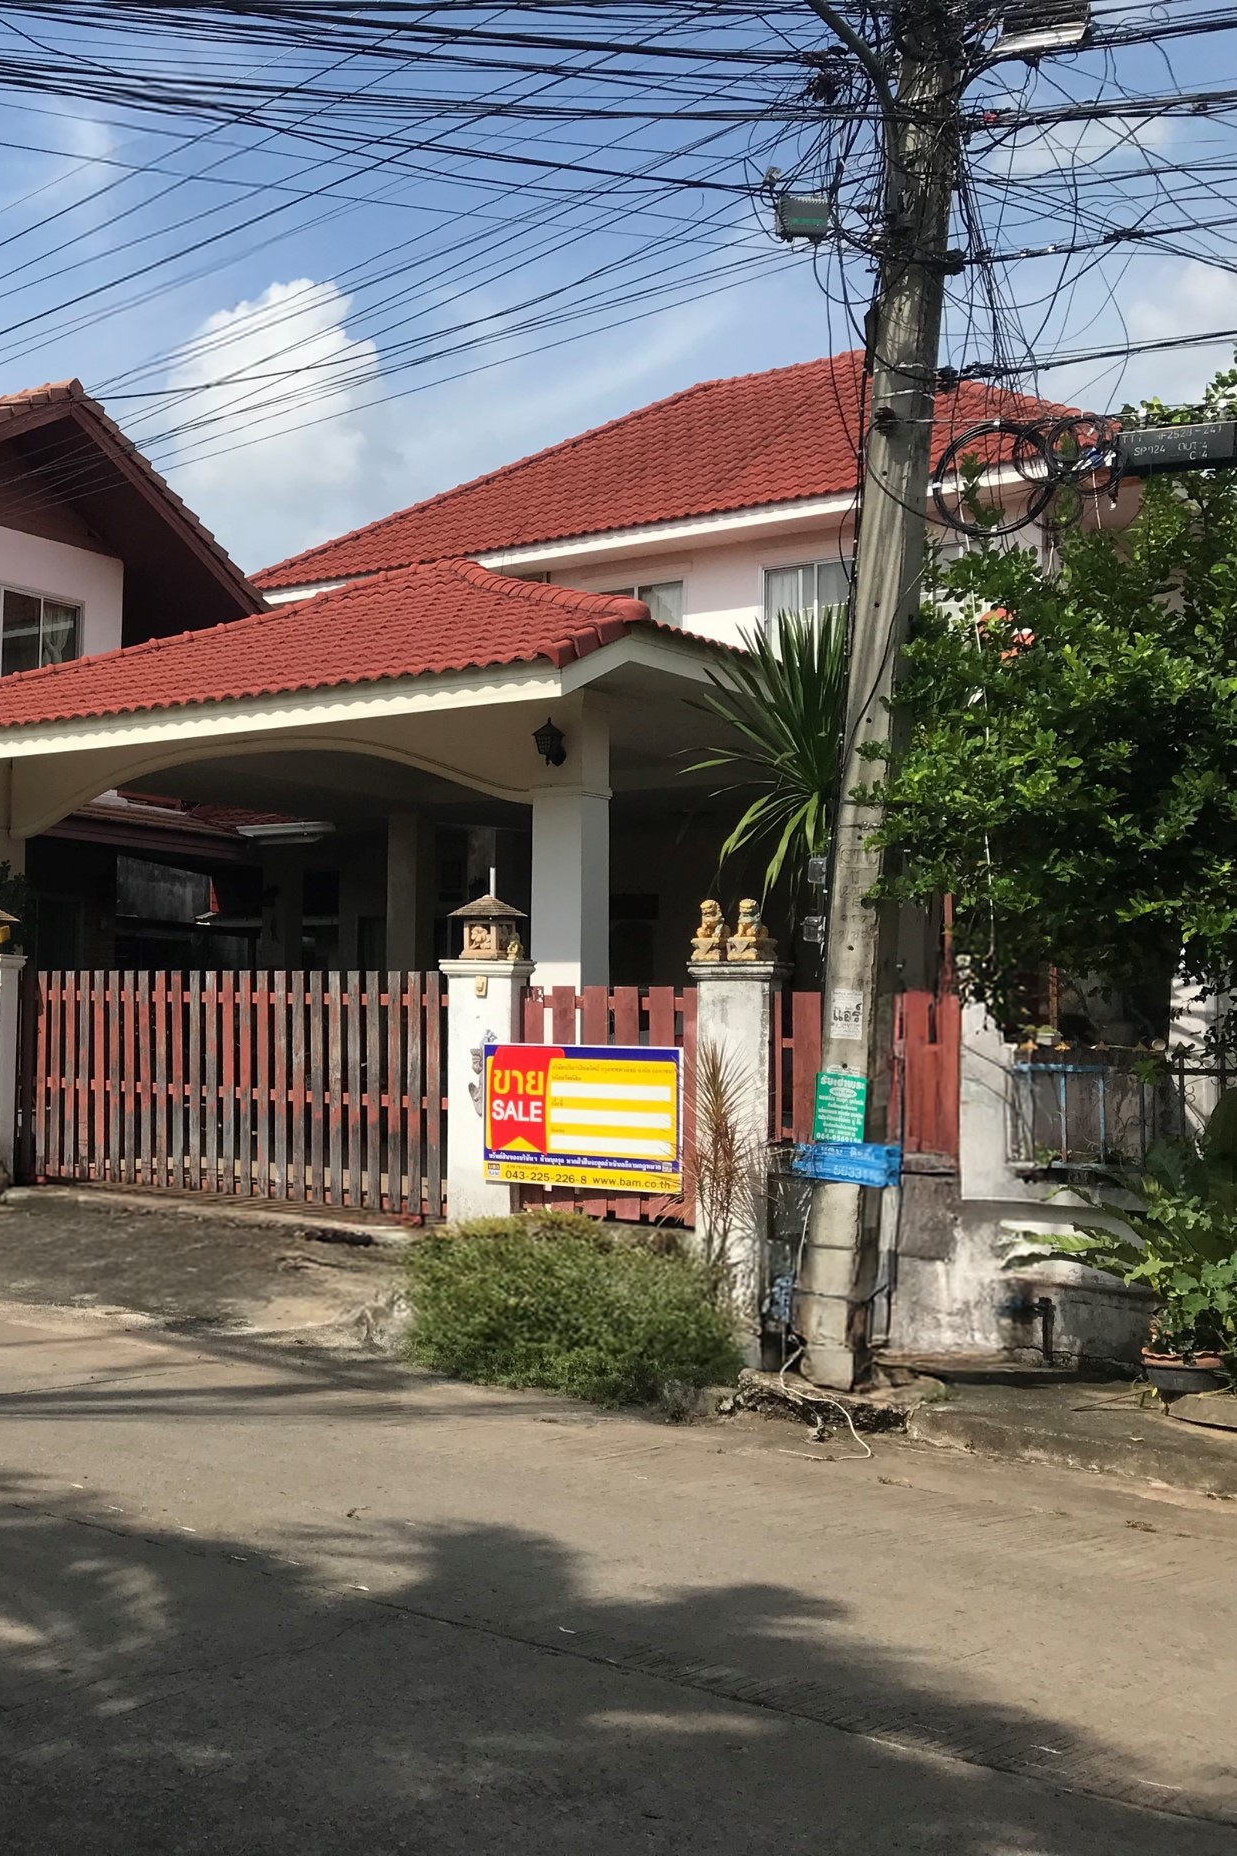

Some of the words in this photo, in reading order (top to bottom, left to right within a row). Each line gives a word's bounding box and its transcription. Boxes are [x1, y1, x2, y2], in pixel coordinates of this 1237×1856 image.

[833, 1002, 863, 1023] แอร์
[493, 1069, 544, 1096] ขาย
[492, 1099, 542, 1122] SALE
[505, 1170, 587, 1184] 043-225-226-8
[592, 1176, 671, 1189] www.bam.co.th
